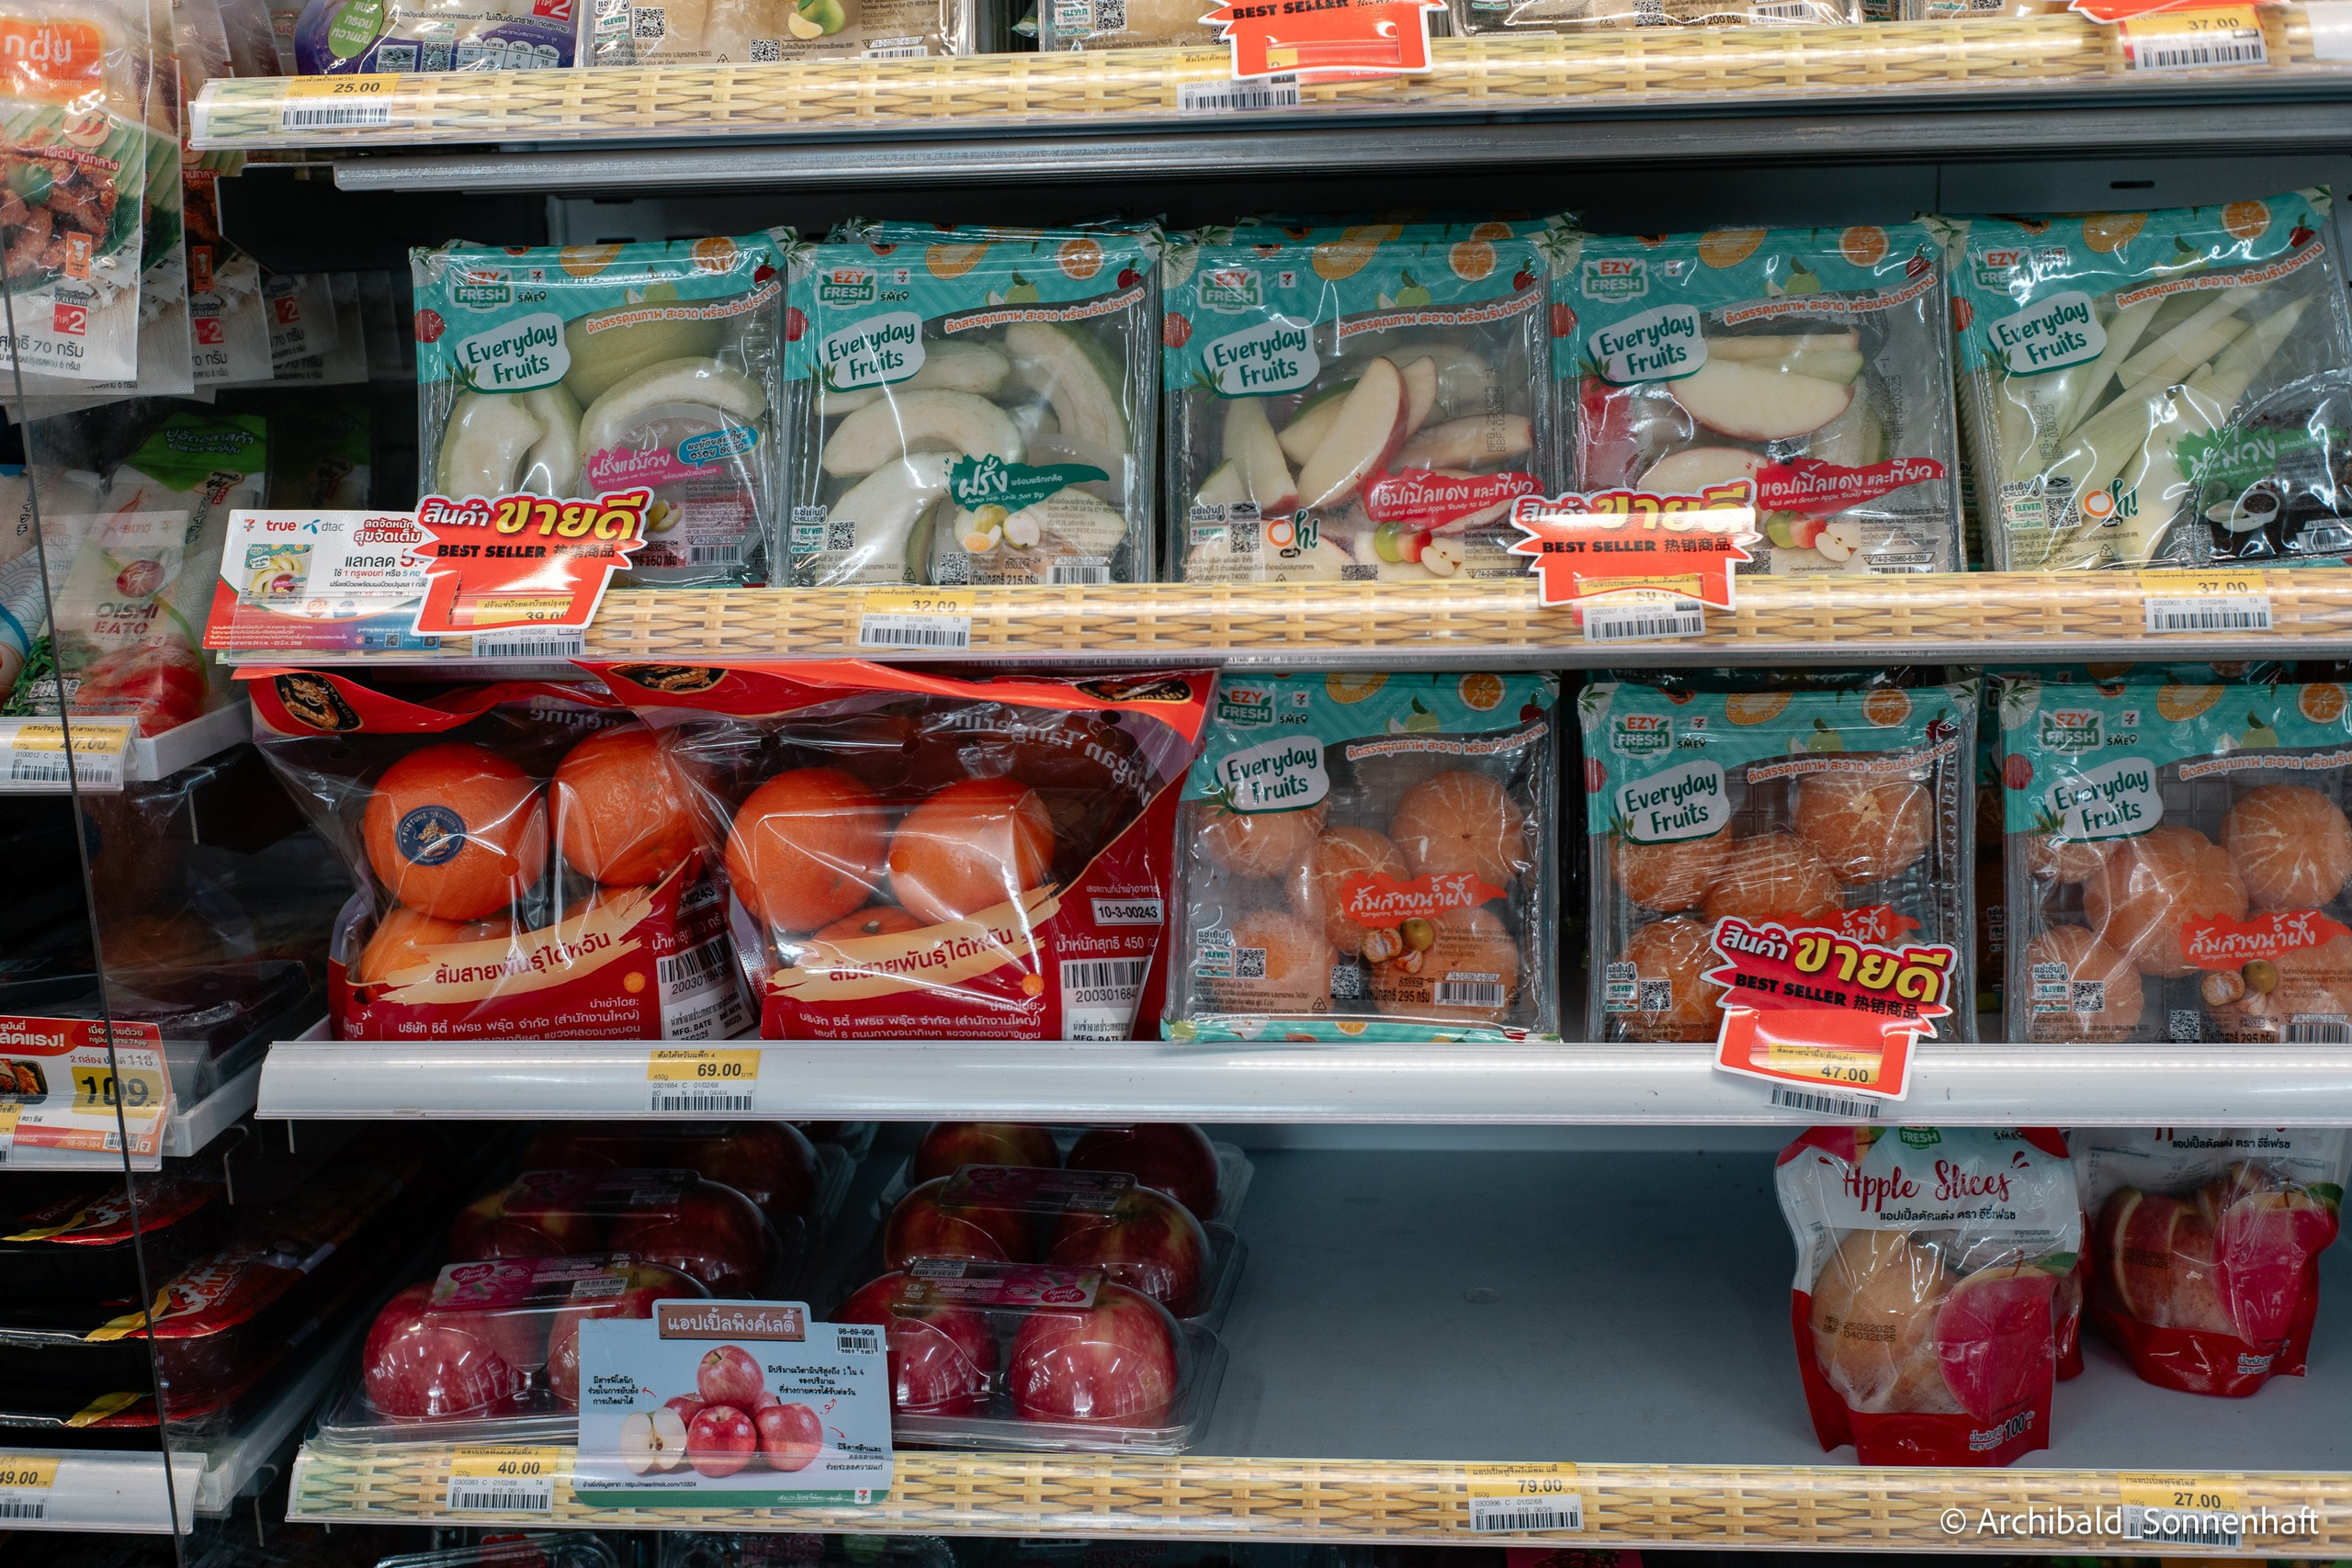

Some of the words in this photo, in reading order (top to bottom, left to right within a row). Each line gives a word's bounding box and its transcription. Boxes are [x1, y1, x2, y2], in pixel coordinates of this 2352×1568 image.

[1233, 6, 1278, 19] BEST
[1707, 15, 1725, 25] 200
[2188, 17, 2240, 30] 37.00
[334, 83, 380, 93] 25.00
[1987, 252, 2019, 265] EZY
[1600, 262, 1632, 275] EZY
[2117, 278, 2195, 309] คัดสรรคุณภาพ
[2199, 275, 2235, 289] สะอาด
[2238, 243, 2324, 286] พร้อมรับประทาน
[833, 272, 865, 284] EZY
[1590, 278, 1640, 290] FRESH
[458, 288, 507, 300] FRESH
[823, 286, 871, 300] FRESH
[1205, 290, 1254, 303] FRESH
[1725, 299, 1806, 325] คัดสรรคุณภาพ
[1809, 299, 1844, 311] สะอาด
[1848, 275, 1937, 312] พร้อมรับประทาน
[587, 310, 663, 334] คัดสรรคุณภาพ
[665, 307, 699, 321] สะอาด
[702, 281, 782, 321] พร้อมรับประทาน
[946, 310, 1023, 333] คัดสรรคุณภาพ
[1025, 310, 1058, 321] สะอาด
[1062, 288, 1145, 321] พร้อมรับประทาน
[1419, 311, 1454, 325] สะอาด
[1457, 290, 1543, 325] พร้อมรับประทาน
[1997, 301, 2089, 347] Everyday
[1600, 314, 1695, 355] Everyday
[34, 340, 51, 354] 70
[57, 340, 85, 358] กรัม
[467, 324, 559, 365] Everyday
[829, 322, 915, 363] Everyday
[1213, 329, 1307, 367] Everyday
[2025, 333, 2086, 366] Fruits
[849, 350, 904, 381] Fruits
[1626, 344, 1687, 376] Fruits
[493, 355, 550, 385] Fruits
[1240, 359, 1298, 388] Fruits
[958, 457, 1008, 499] ฝรั่ง
[1761, 463, 1862, 497] แอปเปิ้ลแดง
[1370, 474, 1469, 509] แอปเปิ้ลแดง
[1597, 487, 1746, 533] ขายดี
[266, 521, 297, 532] true
[322, 522, 345, 532] dtac
[423, 502, 489, 527] สินค้า
[495, 496, 645, 542] ขายดี
[354, 529, 422, 547] สุขจัดเต็ม
[1543, 540, 1587, 553] BEST
[1592, 540, 1657, 552] SELLER
[1664, 537, 1731, 553] 热销商品
[437, 544, 481, 558] BEST
[484, 544, 546, 558] SELLER
[345, 555, 395, 569] แลกลด
[645, 555, 662, 566] 160
[350, 569, 384, 578] ทรูพอยท์
[385, 568, 401, 577] หรือ
[1007, 575, 1023, 585] 215
[2198, 581, 2248, 593] 37.00
[95, 602, 160, 619] OISHI
[911, 600, 956, 613] 32.00
[94, 621, 149, 635] EATO
[1231, 691, 1262, 704] EZY
[1222, 705, 1270, 719] FRESH
[1627, 717, 1659, 729] EZY
[2056, 713, 2088, 727] EZY
[1618, 734, 1666, 747] FRESH
[2046, 729, 2096, 742] FRESH
[1428, 739, 1461, 753] สะอาด
[1227, 748, 1318, 783] Everyday
[2264, 755, 2300, 768] สะอาด
[1748, 761, 1827, 784] คัดสรรคุณภาพ
[1830, 760, 1865, 773] สะอาด
[1252, 777, 1308, 805] Fruits
[1625, 773, 1718, 812] Everyday
[2054, 770, 2150, 810] Everyday
[402, 813, 428, 836] FORTUNE
[430, 811, 457, 827] DRAGON
[1650, 803, 1710, 834] Fruits
[2082, 801, 2142, 831] Fruits
[1350, 874, 1472, 913] ส้มสายน้ำผึ้ง
[1098, 906, 1158, 919] 10-3-00243
[2189, 911, 2315, 954] ส้มสายน้ำผึ้ง
[1056, 936, 1120, 954] น้ำหนักสุทธิ
[1125, 937, 1144, 950] 450
[1722, 928, 1792, 961] สินค้า
[1794, 935, 1947, 1003] ขายดี
[1398, 990, 1415, 1002] 295
[1736, 974, 1780, 993] BEST
[1783, 982, 1847, 1007] SELLER
[1853, 994, 1919, 1020] 热销商品
[589, 998, 639, 1010] นำเข้าโดย:
[398, 1020, 427, 1034] บริษัท
[452, 1019, 481, 1032] เฟรช
[518, 1016, 548, 1030] จำกัด
[554, 1010, 640, 1030] (สำนักงานใหญ่)
[694, 1019, 712, 1032] DATE
[799, 1013, 829, 1027] บริษัท
[854, 1017, 882, 1027] เฟรช
[920, 1014, 949, 1026] จำกัด
[955, 1013, 1041, 1029] (สำนักงานใหญ่)
[814, 1028, 837, 1039] เลขที่
[78, 1055, 102, 1065] กล่อง
[697, 1063, 741, 1077] 69.00
[1821, 1065, 1869, 1083] 47.00
[66, 1139, 101, 1148] 98-99-384
[1903, 1131, 1939, 1143] FRESH
[2236, 1139, 2256, 1148] ตรา
[1843, 1164, 1921, 1213] Apple
[1935, 1159, 2013, 1202] Slices
[1880, 1208, 1954, 1222] แอปเปิ้ลตัดแต่ง
[1957, 1211, 1977, 1220] ตรา
[667, 1307, 796, 1334] แอปเปิ้ลพิงค์เลดี้
[1844, 1322, 1896, 1333] 25022025
[838, 1327, 875, 1336] 98-69-908
[1844, 1331, 1896, 1343] 04032025
[2004, 1413, 2025, 1440] 100
[1985, 1438, 2004, 1450] WEIGHT
[498, 1461, 540, 1475] 40.00
[1518, 1479, 1563, 1494] 79.00
[2174, 1491, 2222, 1508] 27.00
